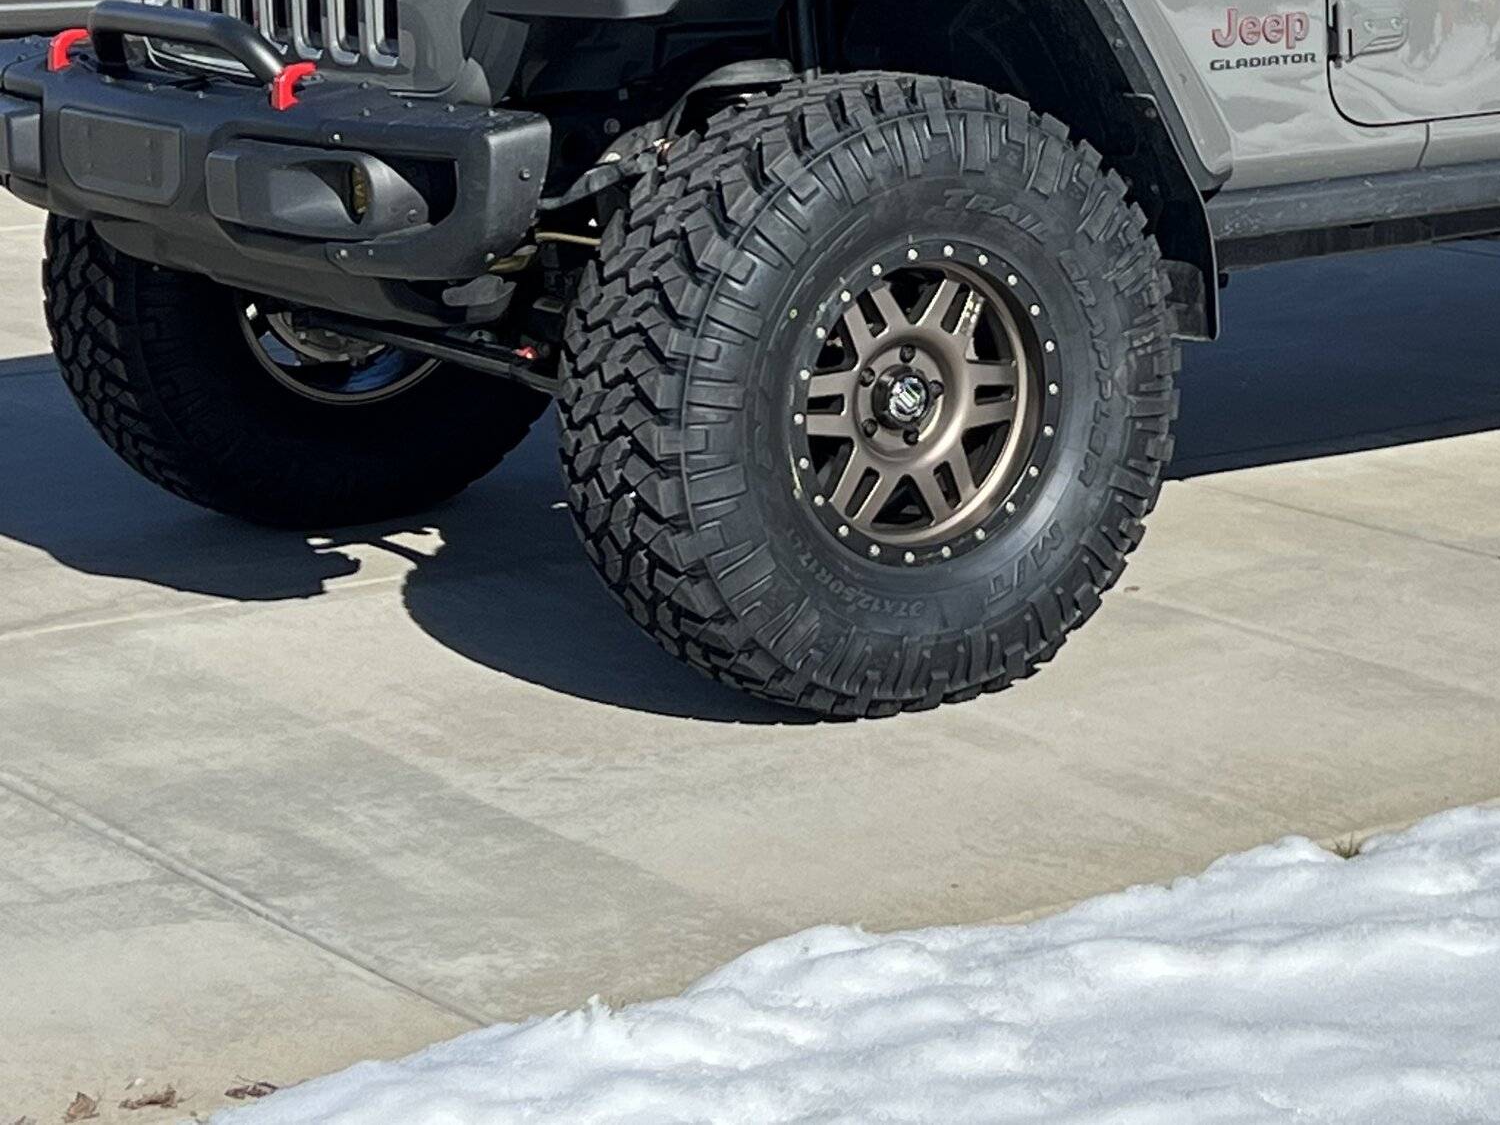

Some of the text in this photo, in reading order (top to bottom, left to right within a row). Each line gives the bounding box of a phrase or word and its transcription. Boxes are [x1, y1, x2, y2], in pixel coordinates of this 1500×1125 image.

[1212, 7, 1310, 50] Jeep
[1209, 52, 1317, 71] GLADIATOR
[944, 188, 1050, 244] TRAIL
[984, 519, 1066, 606] M/T
